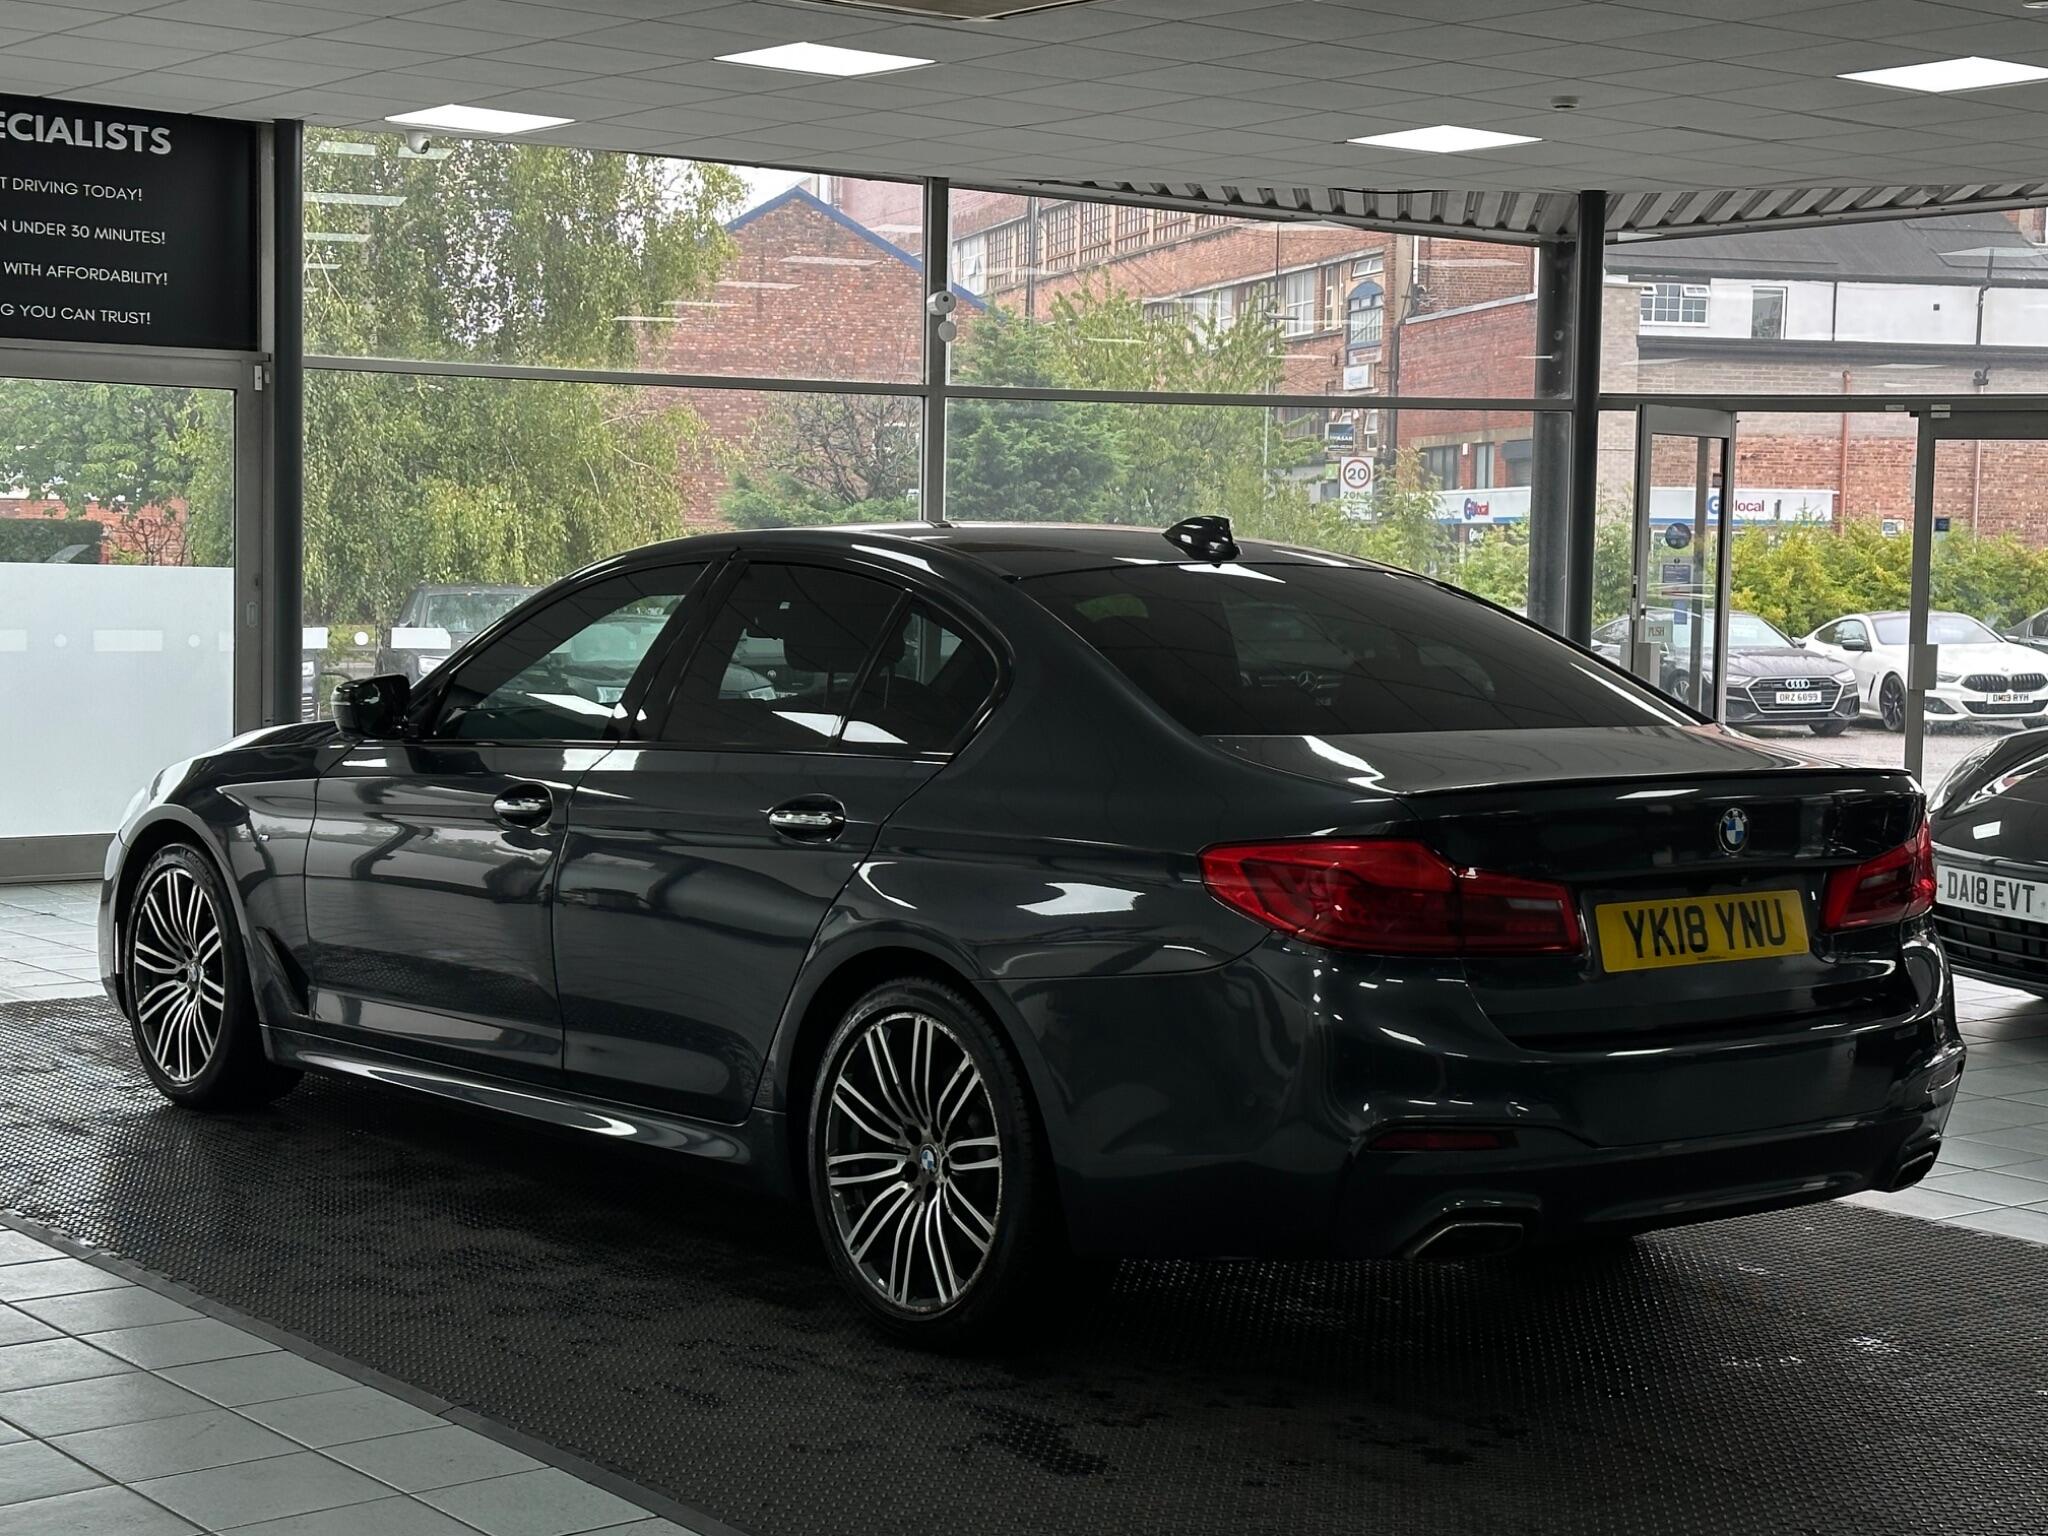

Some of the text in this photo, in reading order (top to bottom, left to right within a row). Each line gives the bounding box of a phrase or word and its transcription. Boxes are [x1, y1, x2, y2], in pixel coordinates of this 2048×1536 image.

[12, 178, 78, 195] DRIVING
[83, 184, 143, 201] TODAY!
[12, 220, 66, 236] UNDER
[71, 224, 90, 238] 30
[94, 227, 166, 244] MINUTES!
[4, 262, 168, 285] WITH AFFORDABILITY!
[19, 304, 56, 319] YOU
[61, 307, 95, 321] CAN
[100, 309, 151, 324] TRUST!
[1347, 467, 1367, 480] 20
[1735, 500, 1764, 512] local
[1947, 871, 2036, 913] DA18 EVT
[1623, 899, 1787, 959] YK18 YNU
